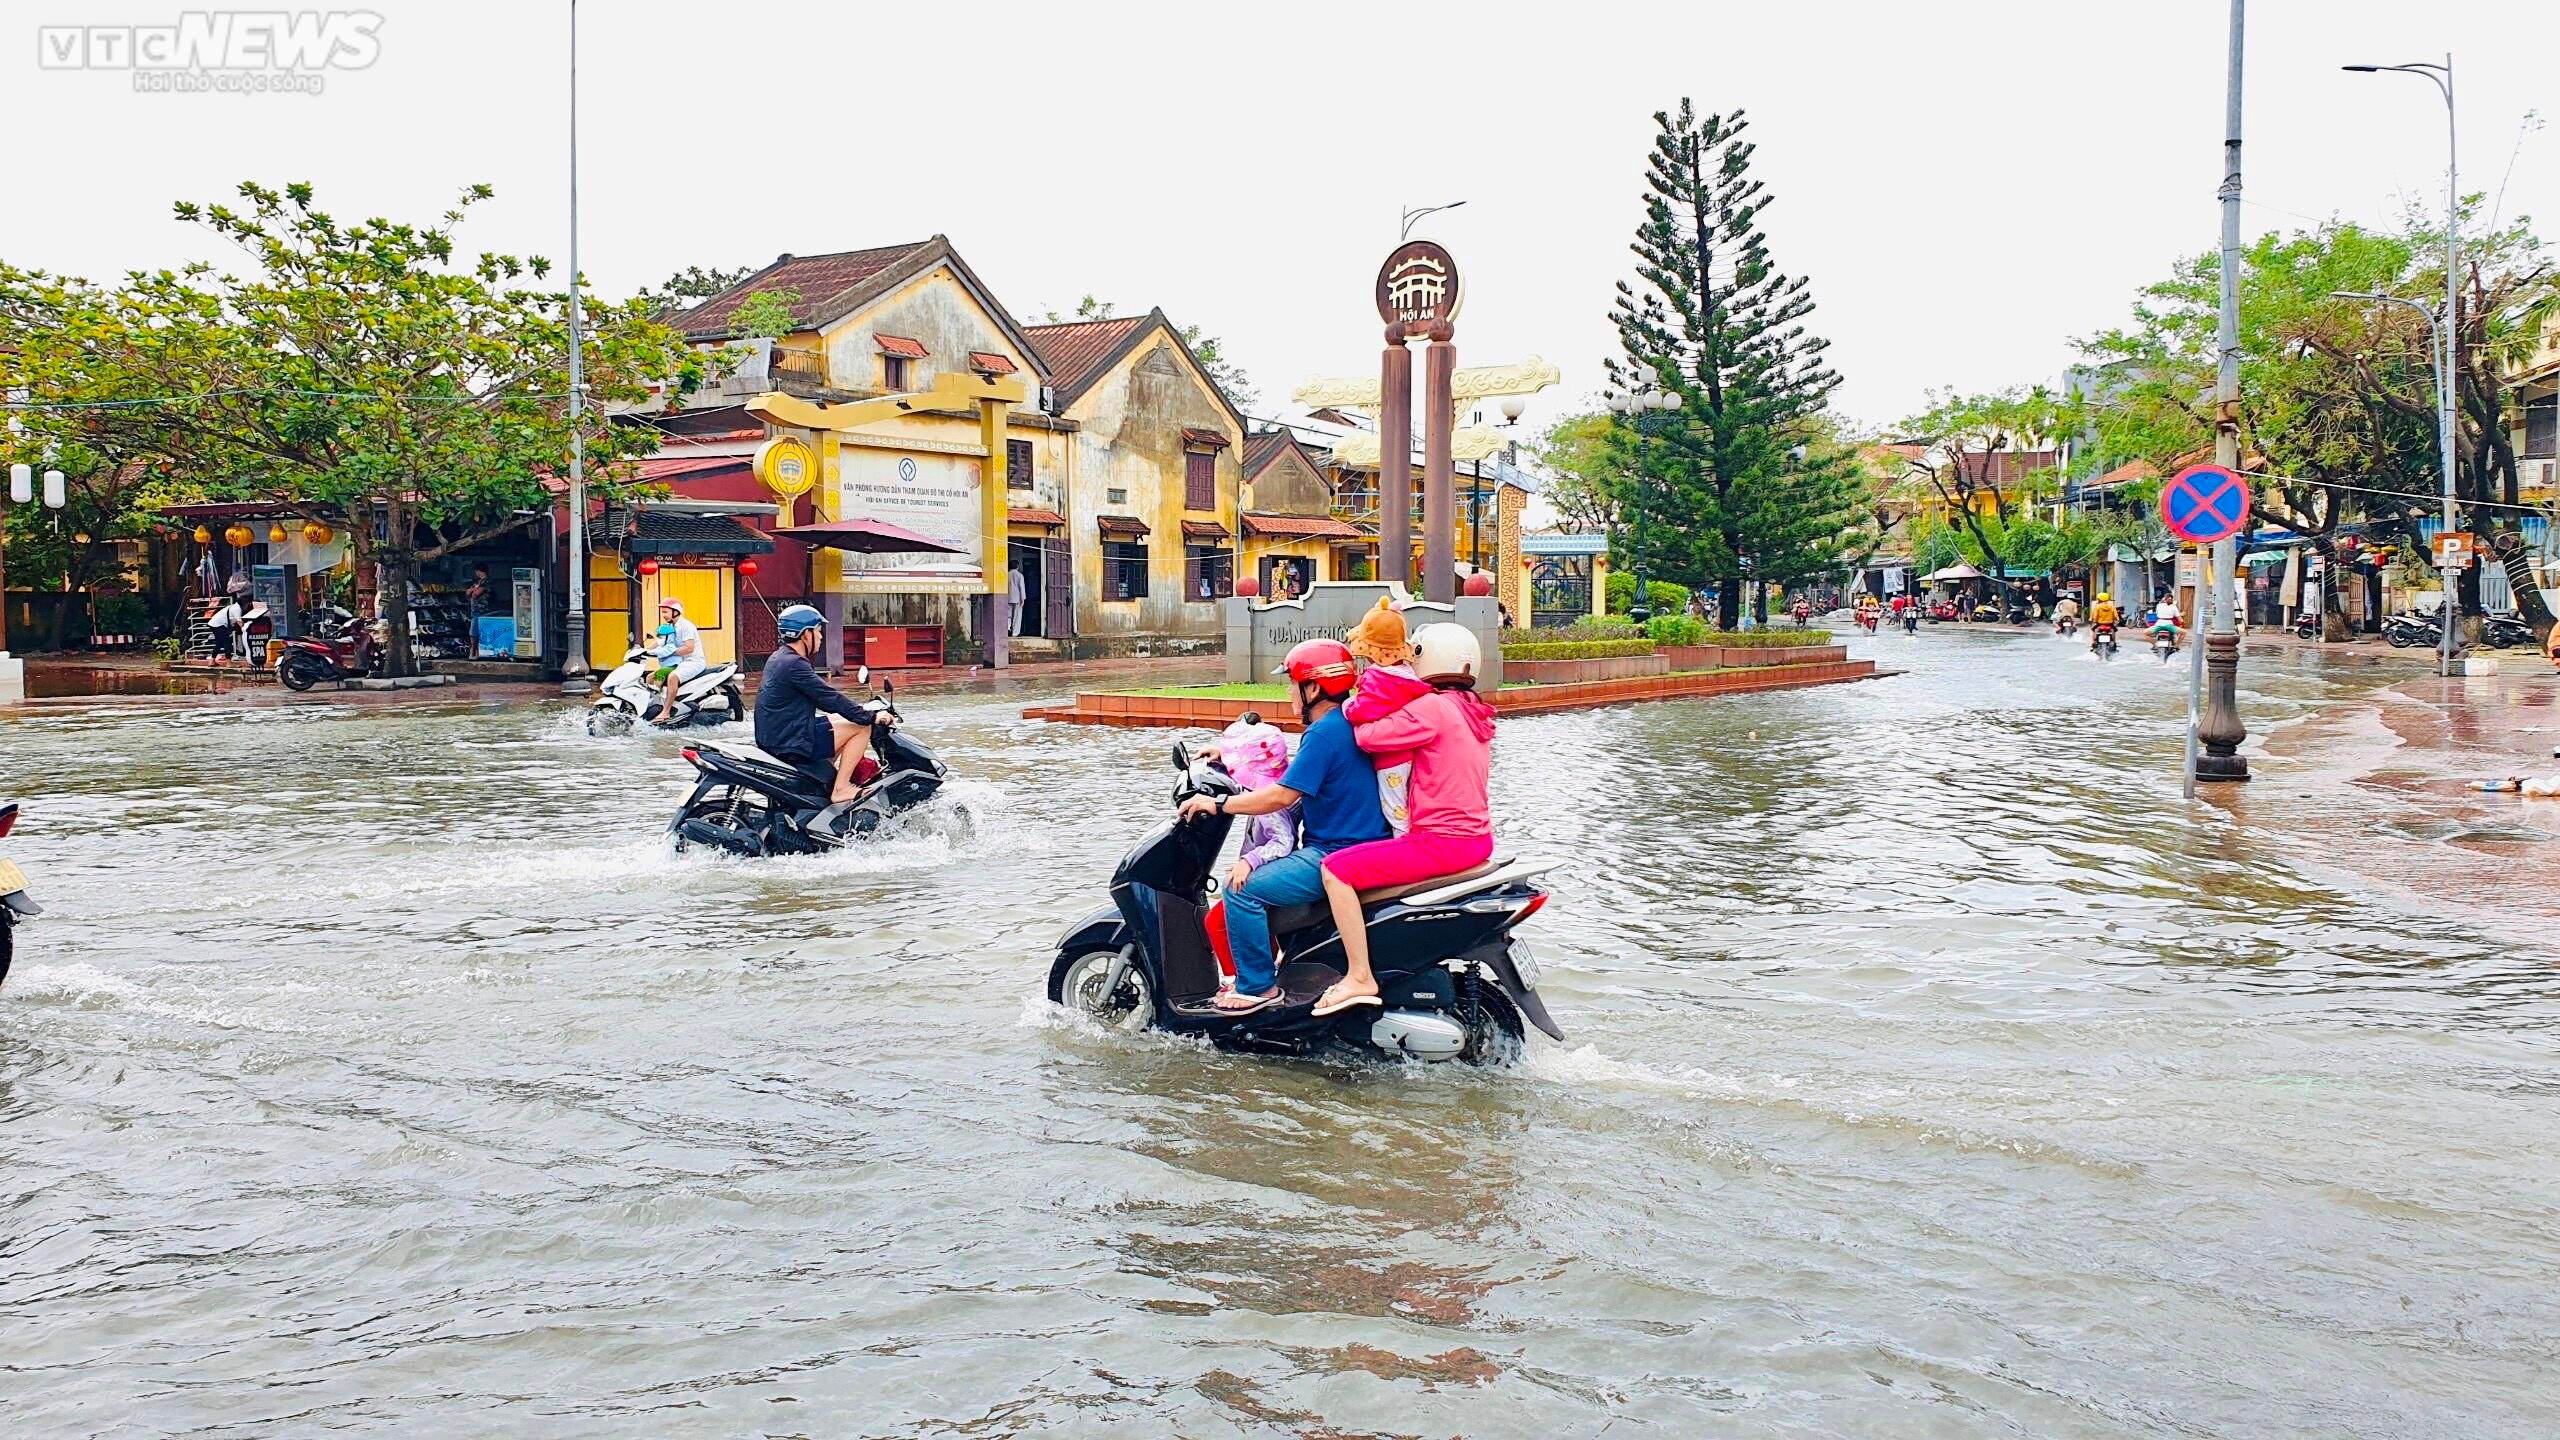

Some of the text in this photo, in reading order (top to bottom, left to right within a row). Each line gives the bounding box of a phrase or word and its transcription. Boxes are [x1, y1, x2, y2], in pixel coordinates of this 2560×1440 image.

[1399, 308, 1435, 323] HỘI AN
[2443, 538, 2462, 559] P
[1268, 619, 1349, 645] QUẢNG TRƯỜ
[252, 646, 266, 658] SPA
